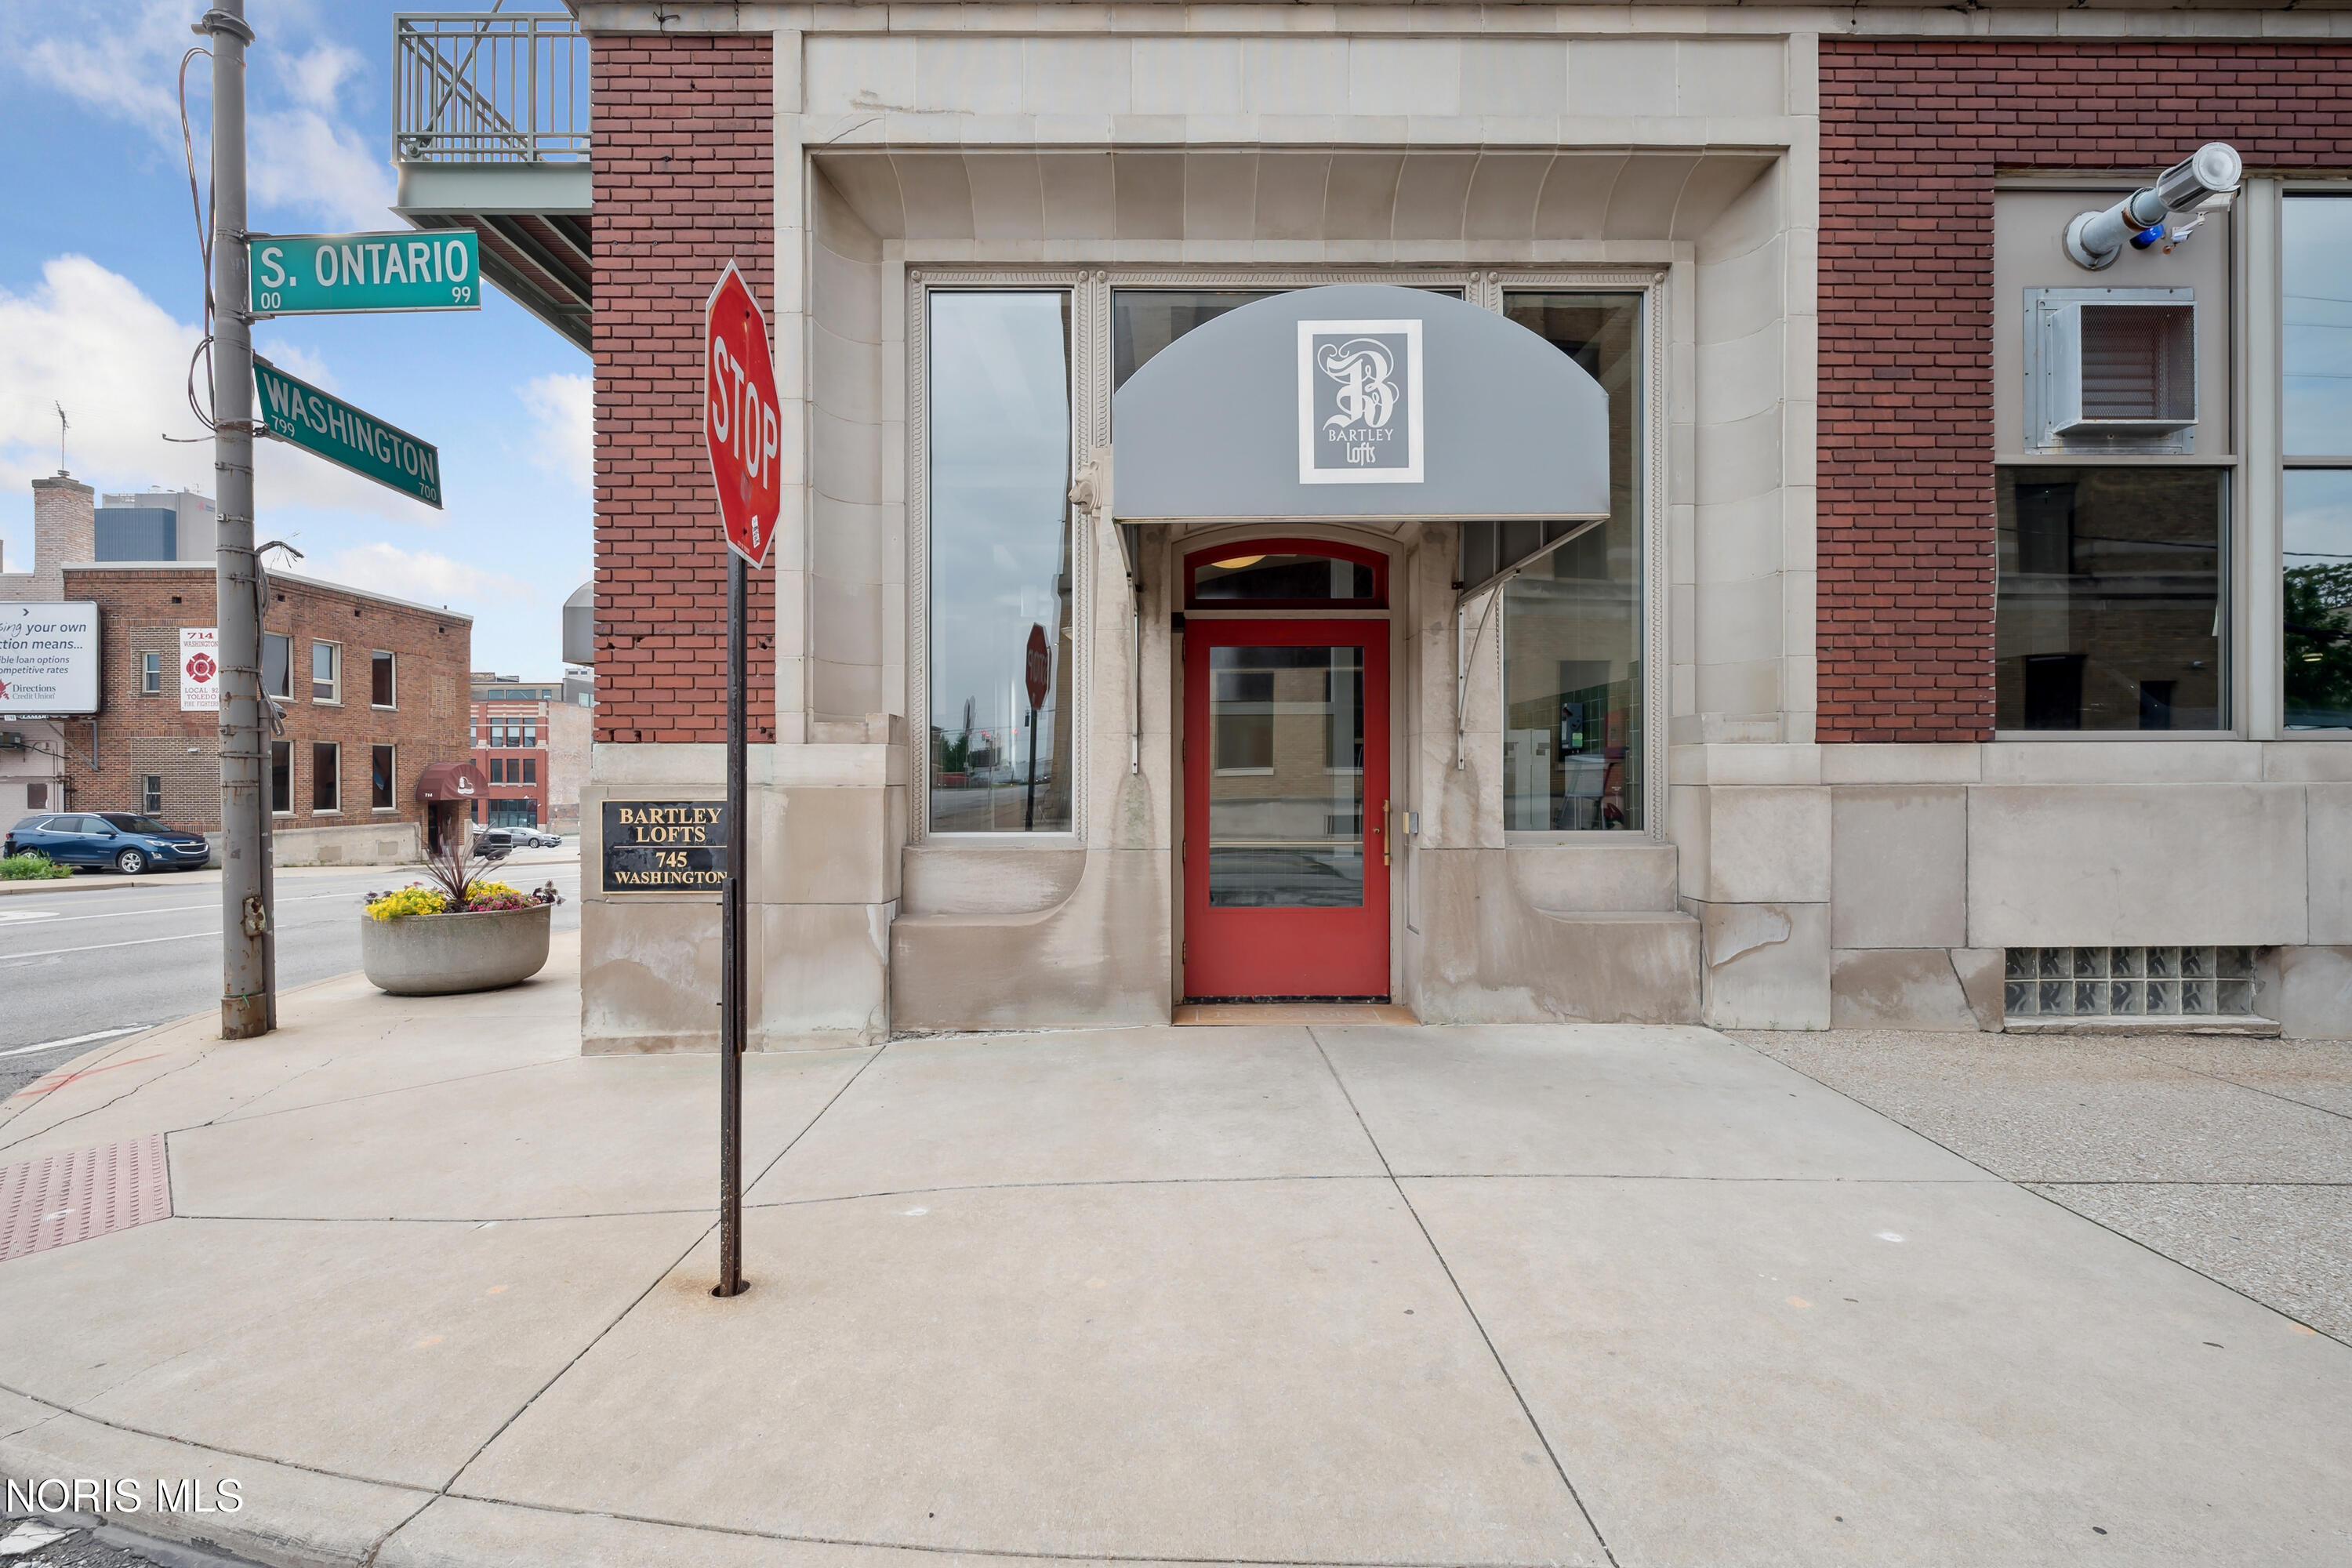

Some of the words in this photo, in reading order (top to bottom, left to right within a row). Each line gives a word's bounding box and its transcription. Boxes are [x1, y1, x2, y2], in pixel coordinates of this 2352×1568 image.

[260, 246, 296, 288] S.
[314, 239, 469, 287] ONTARIO
[260, 292, 281, 310] 00
[452, 285, 471, 303] 99
[712, 335, 778, 490] STOP
[263, 372, 435, 485] WASHINGTON
[270, 414, 296, 437] 799
[1328, 429, 1394, 442] BARTLEY
[419, 482, 437, 502] 700
[25, 624, 56, 636] your
[60, 624, 87, 633] own
[32, 641, 83, 650] means...
[16, 655, 35, 664] loan
[37, 655, 70, 666] options
[619, 808, 723, 824] BARTLEY
[636, 826, 706, 844] LOFTS
[655, 851, 688, 868] 745
[614, 871, 728, 884] WASHINGTON
